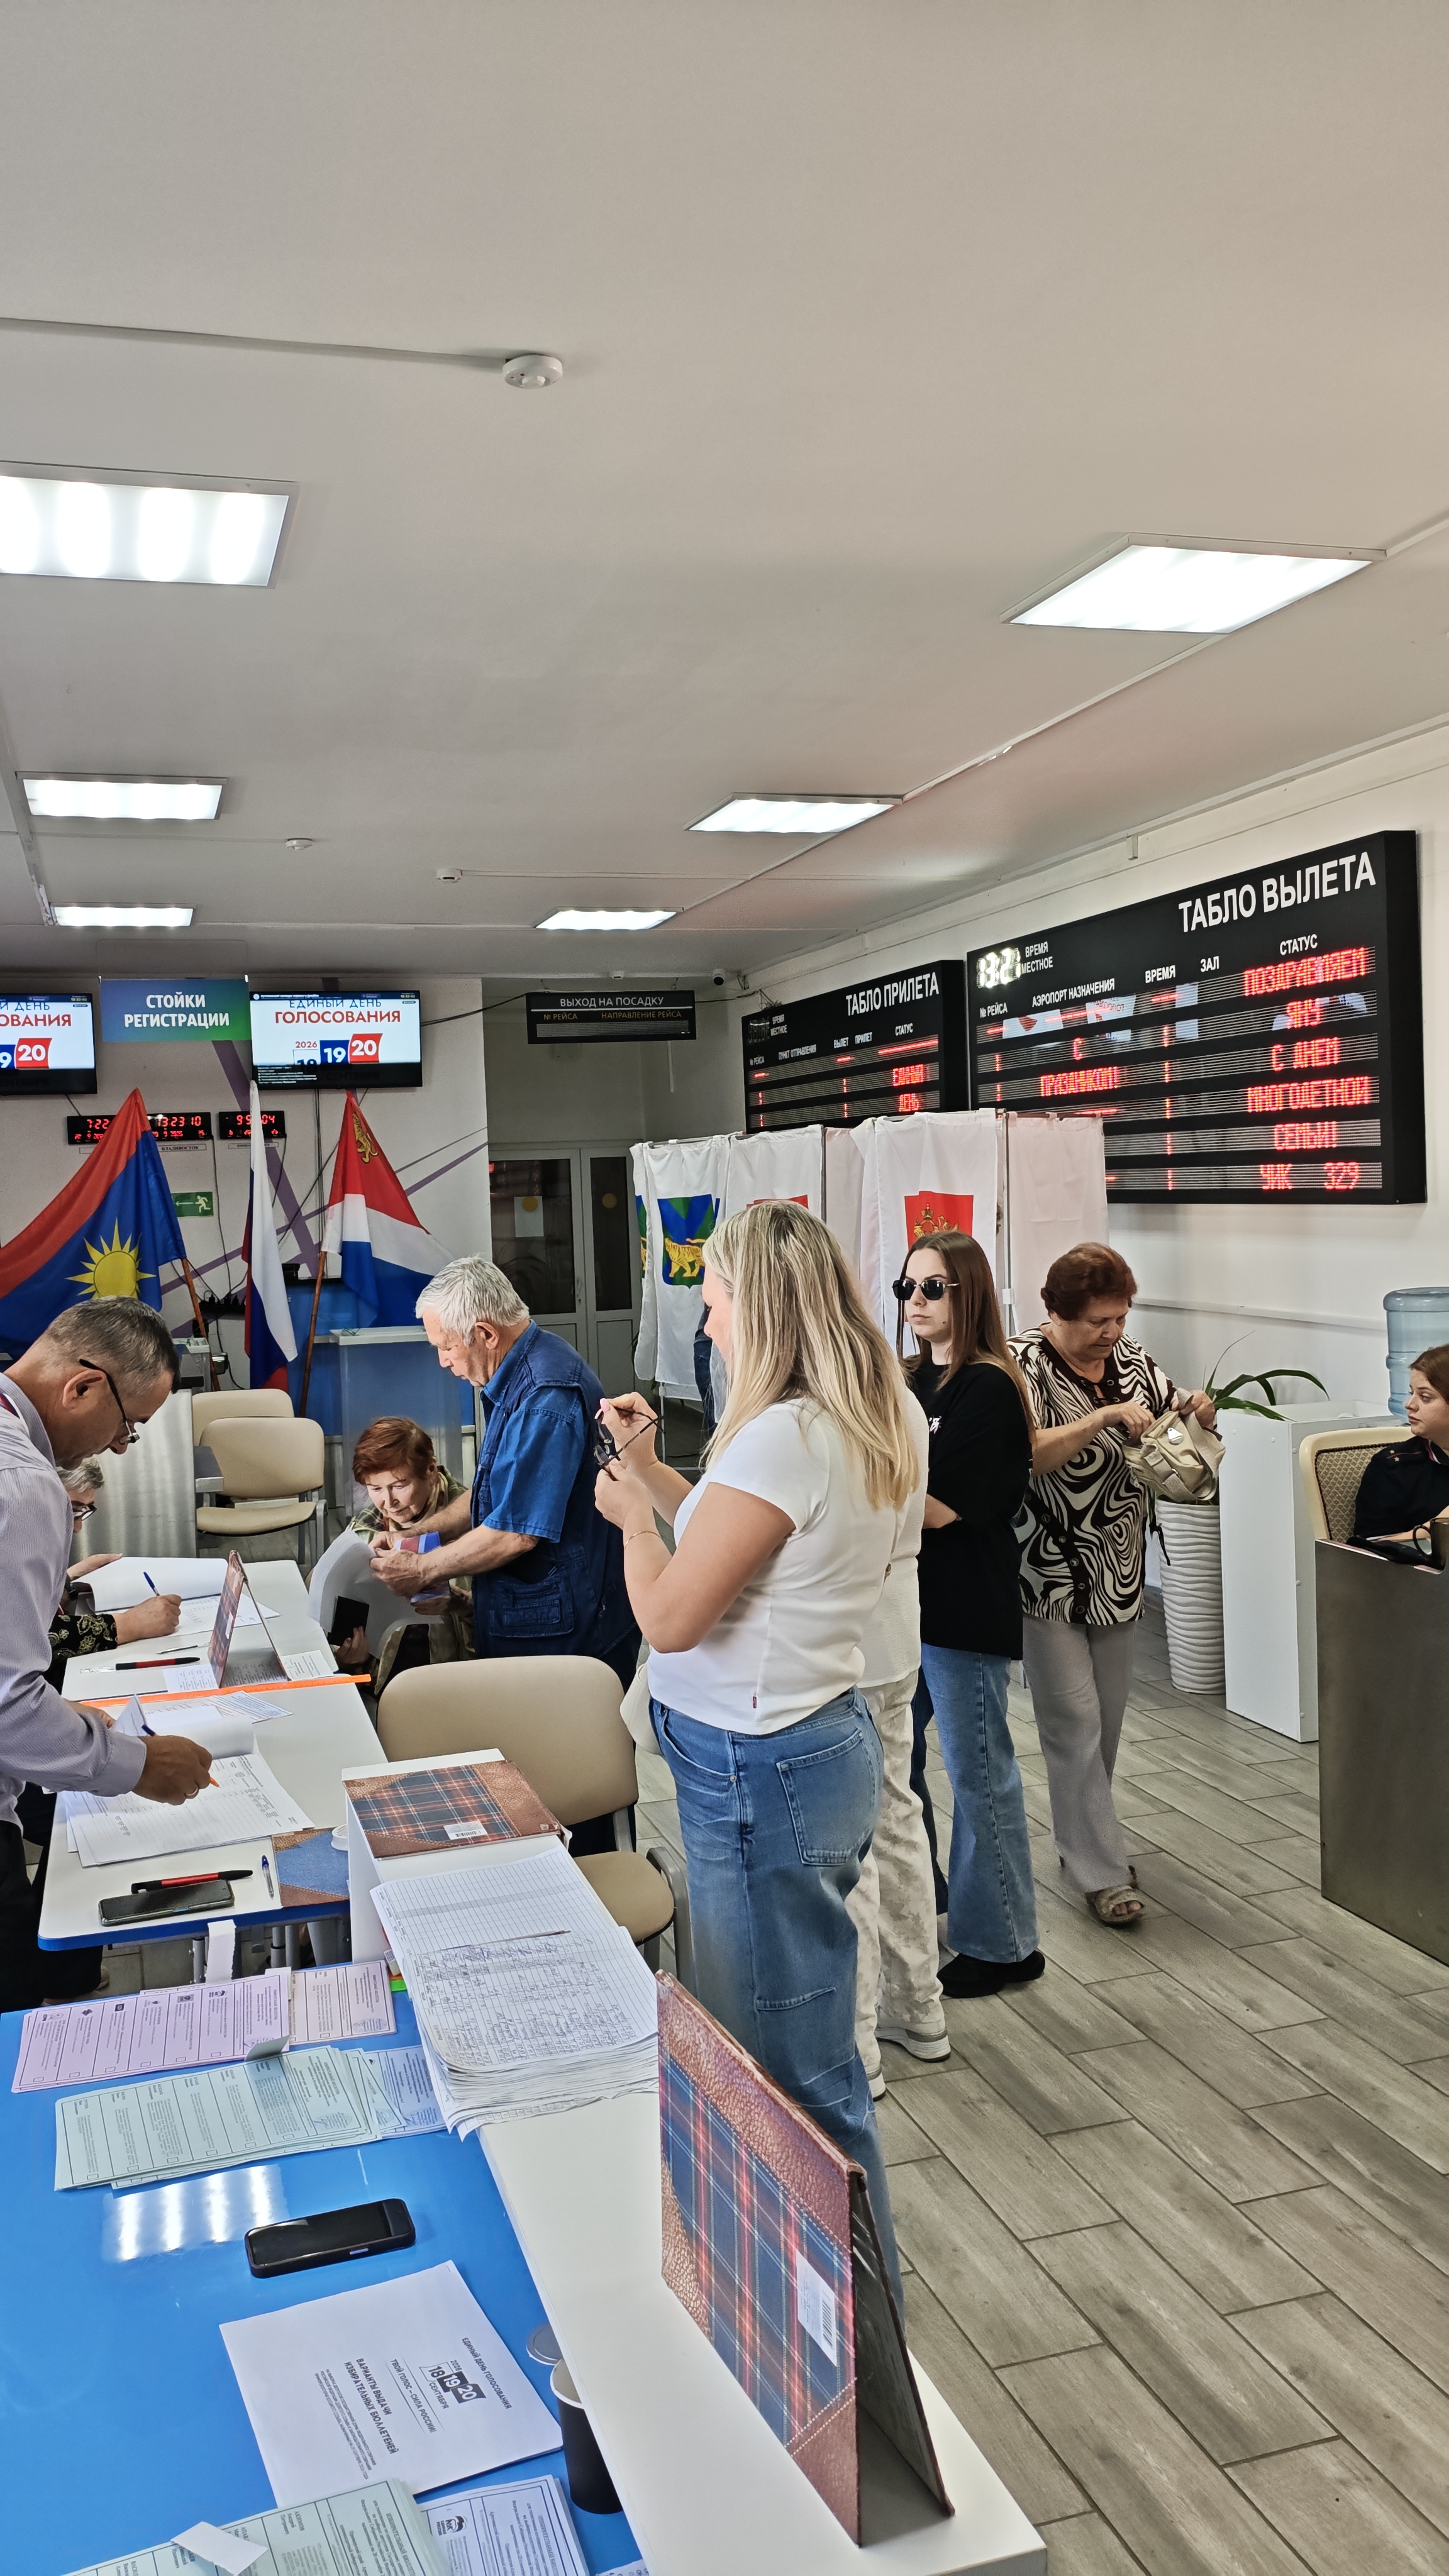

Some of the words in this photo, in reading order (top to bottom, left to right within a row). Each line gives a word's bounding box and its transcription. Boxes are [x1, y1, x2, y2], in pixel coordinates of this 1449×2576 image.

[1179, 884, 1257, 933] ТАБЛО
[1263, 852, 1376, 912] ВЫЛЕТА
[1025, 941, 1048, 958] ВРЕМЯ
[1279, 934, 1318, 955] СТАТУС
[1021, 957, 1053, 974] МЕСТНОЕ
[1145, 965, 1176, 984] ВРЕМЯ
[1200, 956, 1220, 973] ЗАЛ
[1243, 947, 1365, 996] ПОЗДРАВЛЯЕМ
[146, 992, 206, 1009] СТОЙКИ
[560, 998, 597, 1008] ВЫХОД
[599, 997, 613, 1006] НА
[616, 997, 664, 1006] ПОСАДКУ
[846, 988, 881, 1016] ТАБЛО
[884, 972, 939, 1007] ПРИЛЕТА
[1032, 989, 1067, 1008] АЭРОПОРТ
[1069, 978, 1115, 1000] НАЗНАЧЕНИЯ
[14, 1002, 50, 1011] ДЕНЬ
[289, 999, 344, 1009] ЕДИНЫЙ
[349, 999, 382, 1009] ДЕНЬ
[980, 1008, 986, 1018] №
[987, 1002, 1008, 1017] РЕЙСА
[0, 1014, 72, 1026] ОВАНИЯ
[124, 1013, 230, 1029] РЕГИСТРАЦИИ
[275, 1011, 401, 1023] ГОЛОСОВАНИЯ
[855, 1032, 872, 1045] ПРИЛЕТ
[895, 1023, 913, 1036] СТАТУС
[323, 1047, 346, 1063] 19
[351, 1040, 377, 1056] 20
[833, 1037, 849, 1049] ВЫЛЕТ
[1293, 1036, 1339, 1070] ДНЕМ
[0, 1052, 12, 1069] 9
[18, 1044, 46, 1062] 20
[1247, 1075, 1369, 1113] МНОГОДЕТНОЙ
[1324, 1162, 1359, 1190] 329
[450, 2358, 462, 2372] 2026
[461, 2336, 479, 2358] ЕДИНЫЙ
[474, 2356, 488, 2372] ДЕНЬ
[482, 2370, 512, 2410] ГОЛОСОВАНИЯ
[355, 2357, 379, 2390] ВАРИАНТЫ
[372, 2388, 392, 2416] ВЫДАЧИ
[428, 2364, 445, 2379] 18
[443, 2373, 462, 2389] 19
[457, 2382, 477, 2402] 20
[390, 2357, 404, 2373] ТВОЙ
[397, 2372, 412, 2390] ГОЛОС
[409, 2392, 423, 2409] СИЛА
[418, 2407, 436, 2433] РОССИИ!
[428, 2381, 450, 2409] СЕНТЯБРЯ
[343, 2360, 375, 2412] ИЗБИРАТЕЛЬНЫХ
[369, 2409, 399, 2455] БЮЛЛЕТЕНЕЙ
